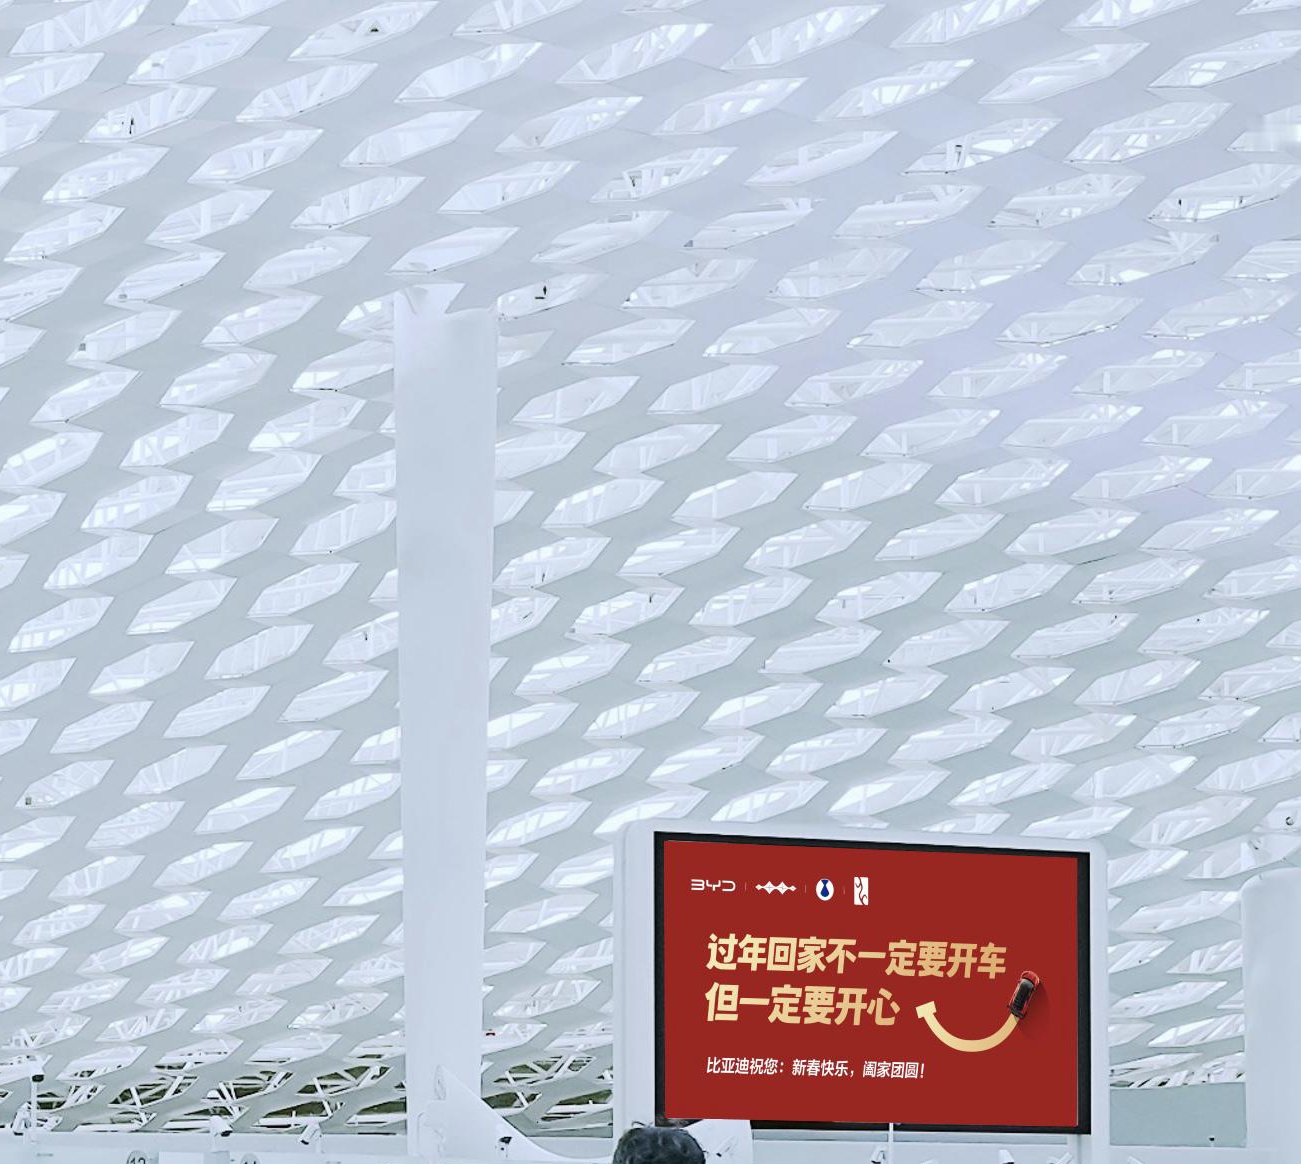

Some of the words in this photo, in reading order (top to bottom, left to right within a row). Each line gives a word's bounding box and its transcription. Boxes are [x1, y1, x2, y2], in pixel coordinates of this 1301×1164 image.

[691, 879, 736, 892] BYD
[706, 933, 1006, 979] 过年回家不一定要开车
[705, 982, 900, 1025] 但一定要开心
